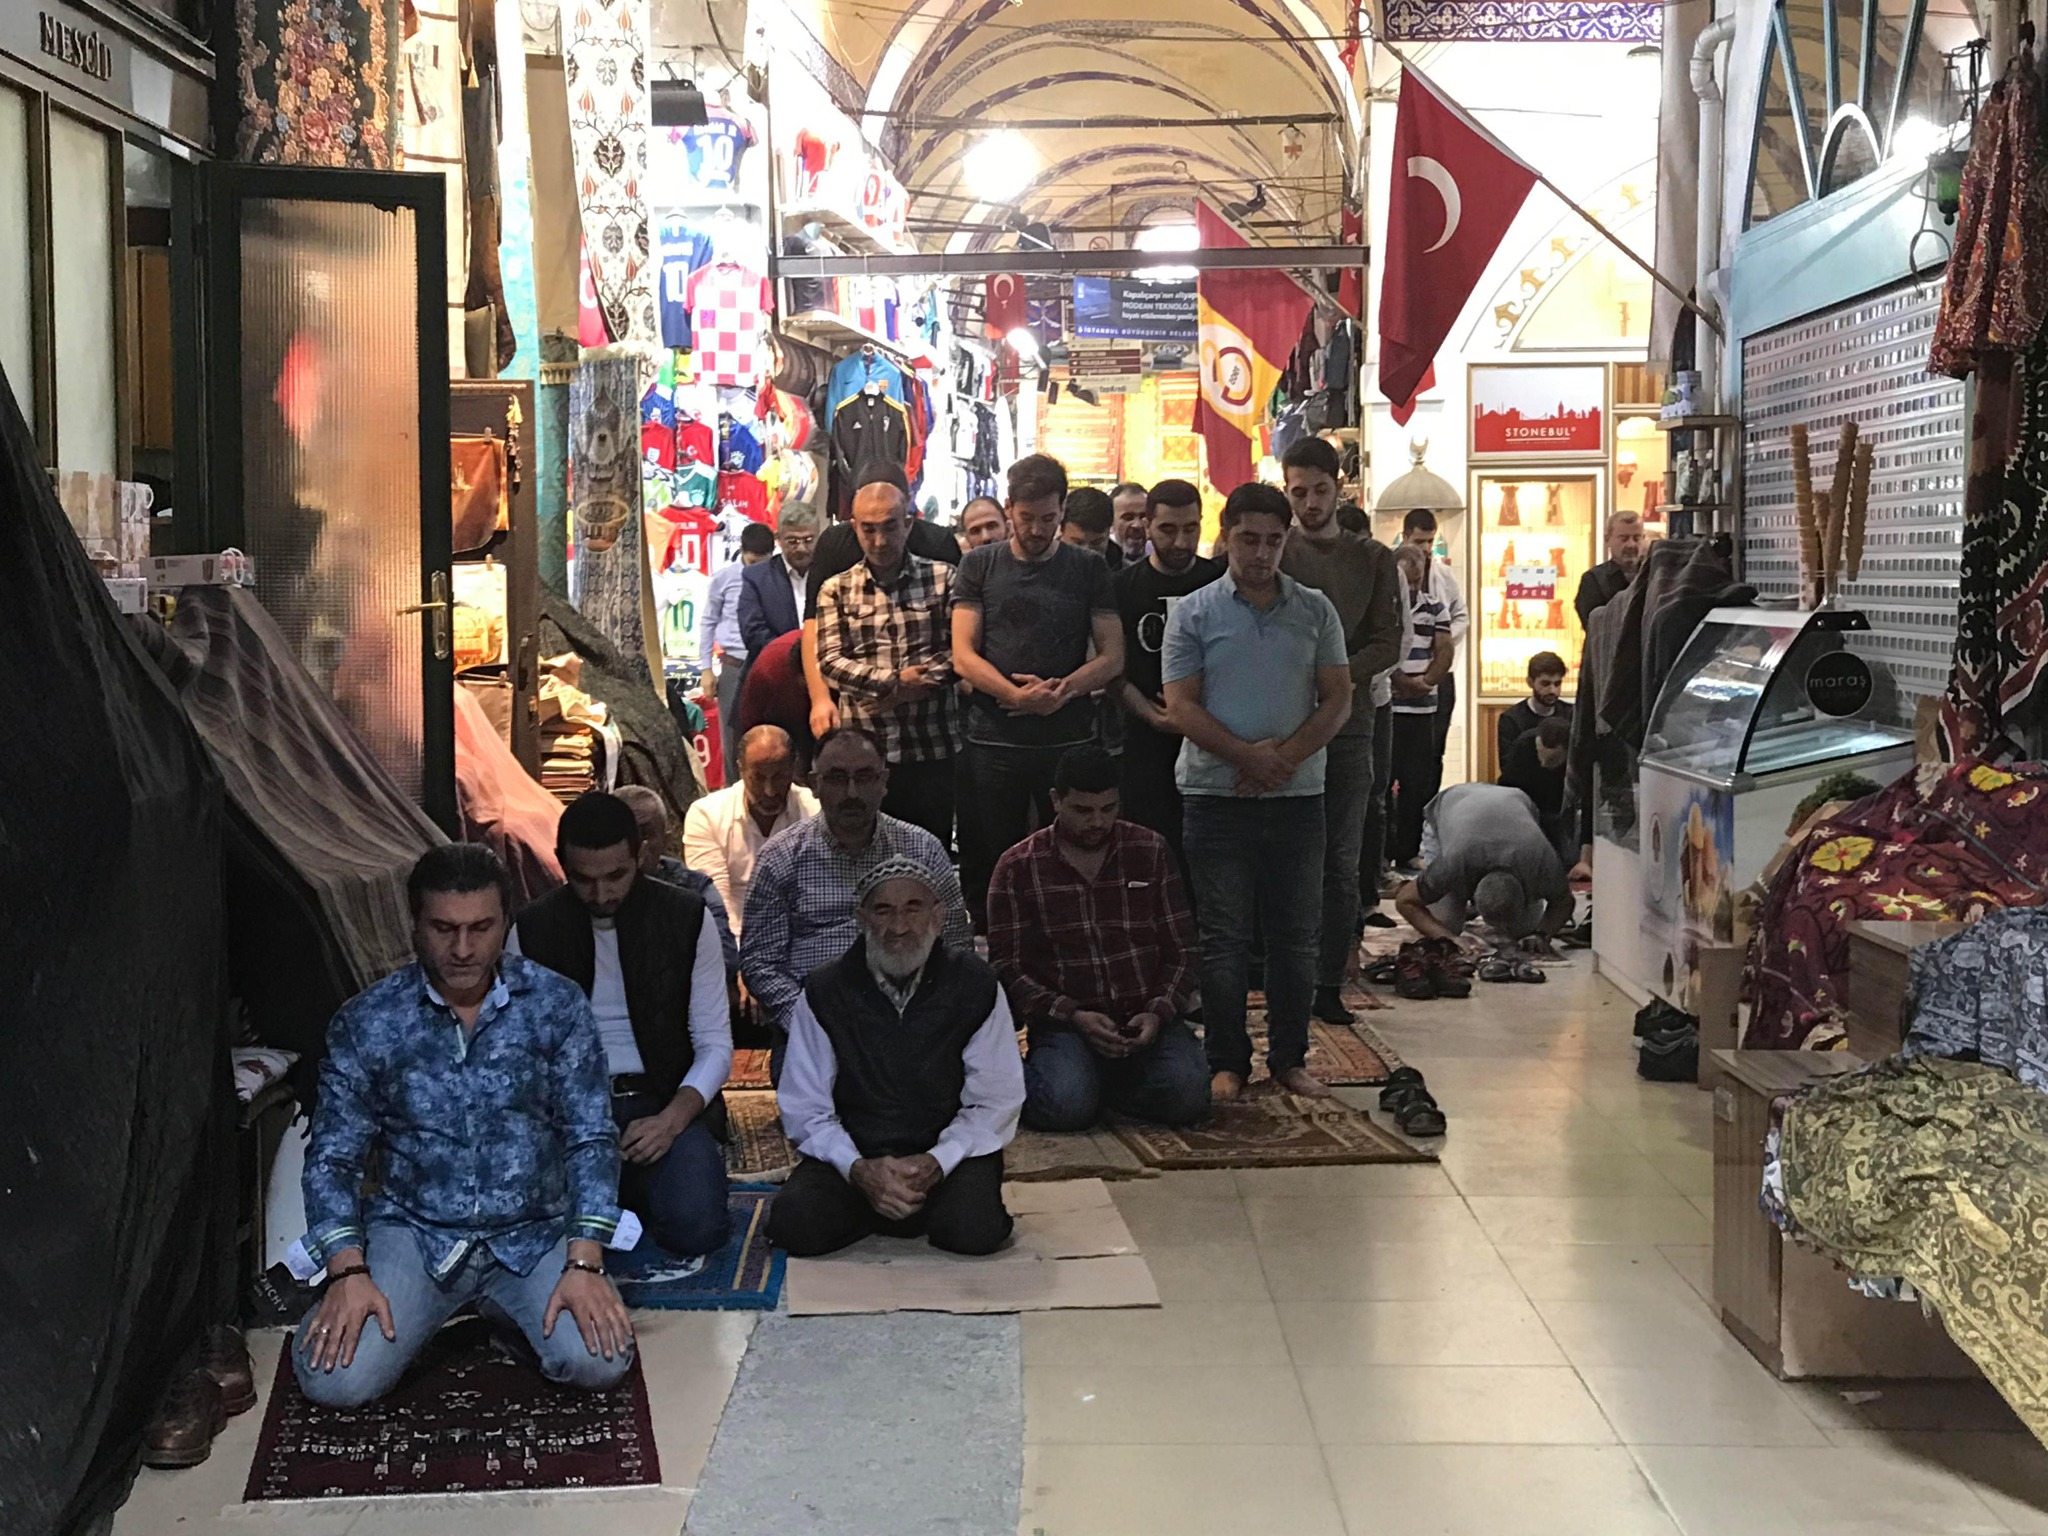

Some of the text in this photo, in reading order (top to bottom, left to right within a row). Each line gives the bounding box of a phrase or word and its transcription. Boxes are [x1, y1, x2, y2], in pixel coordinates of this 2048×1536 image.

[696, 135, 734, 171] 10
[1511, 589, 1548, 597] OPEN
[672, 600, 694, 633] 10
[693, 735, 711, 768] 9
